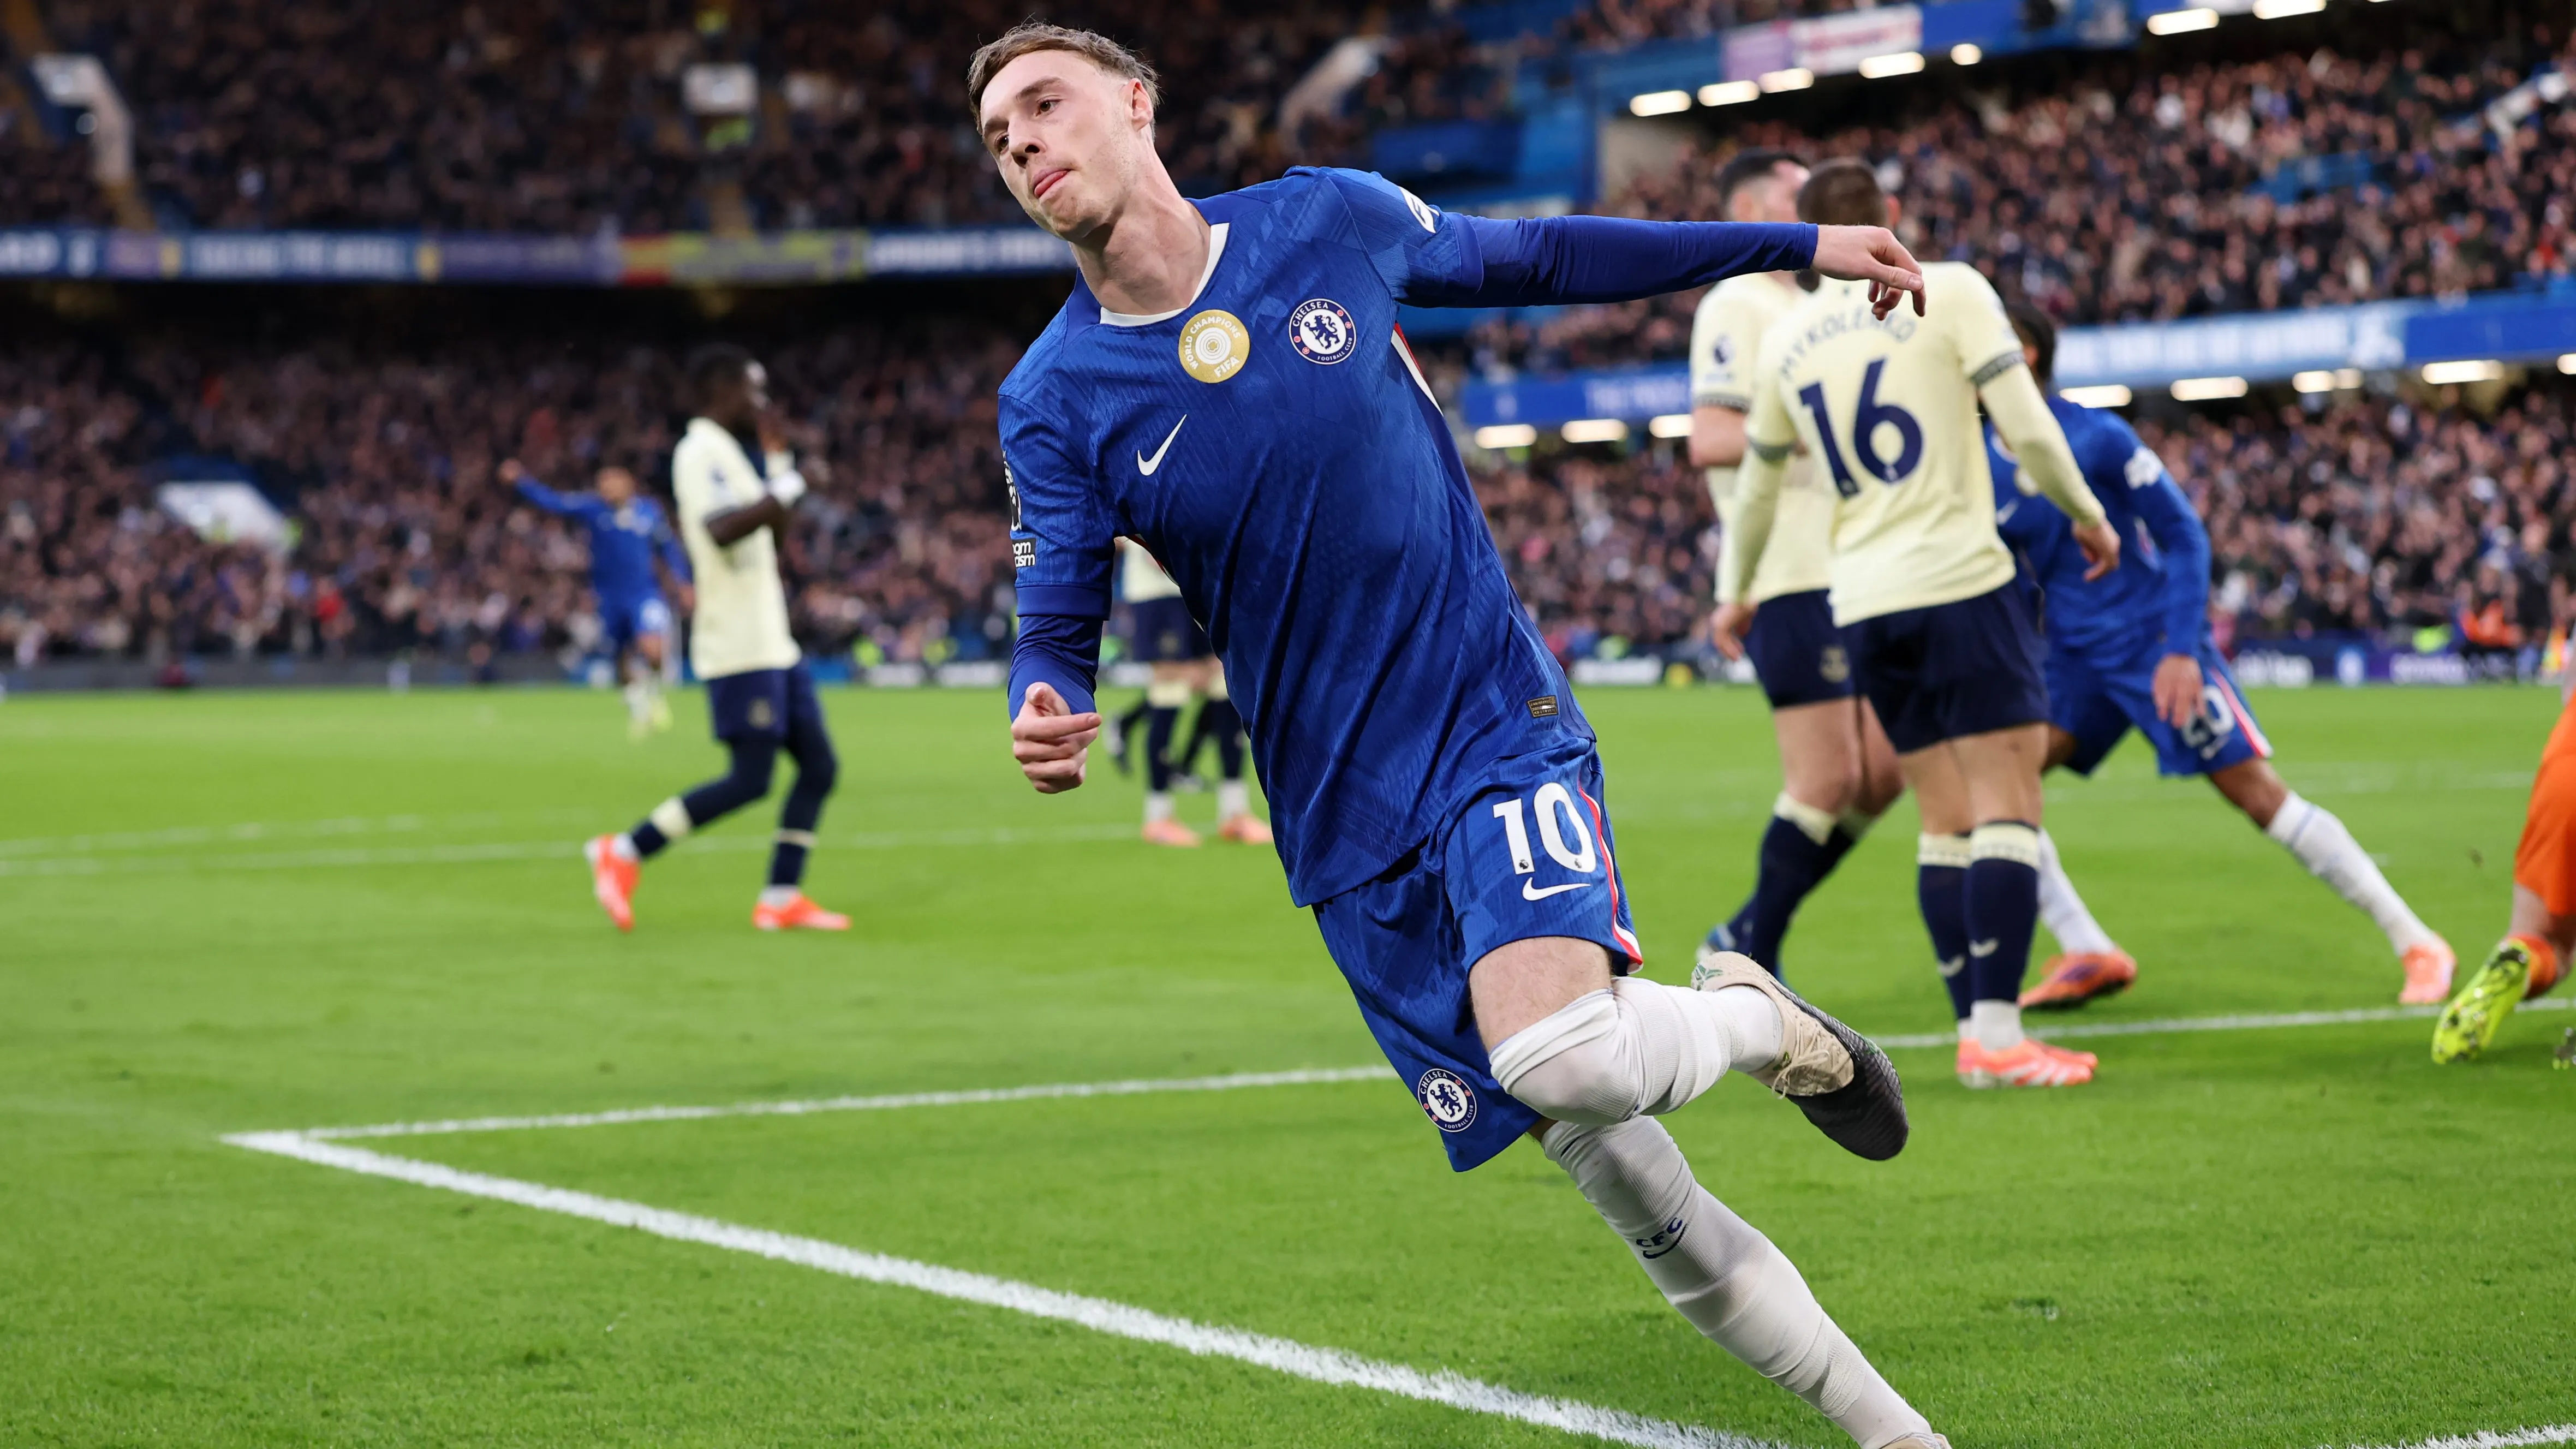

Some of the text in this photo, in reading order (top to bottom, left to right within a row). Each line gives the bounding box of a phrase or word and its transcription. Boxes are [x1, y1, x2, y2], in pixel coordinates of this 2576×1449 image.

[1292, 301, 1328, 327] CHELSEA
[1185, 317, 1241, 369] WORLD CHAMPIONS
[1317, 351, 1345, 361] FOOTBALL
[1214, 355, 1240, 377] FIFA
[1798, 354, 1923, 500] 16
[1493, 782, 1596, 875] 10
[1420, 1071, 1447, 1094] CHELSEA
[1445, 1119, 1468, 1129] FOOTBALL
[1636, 1217, 1683, 1247] CFC
